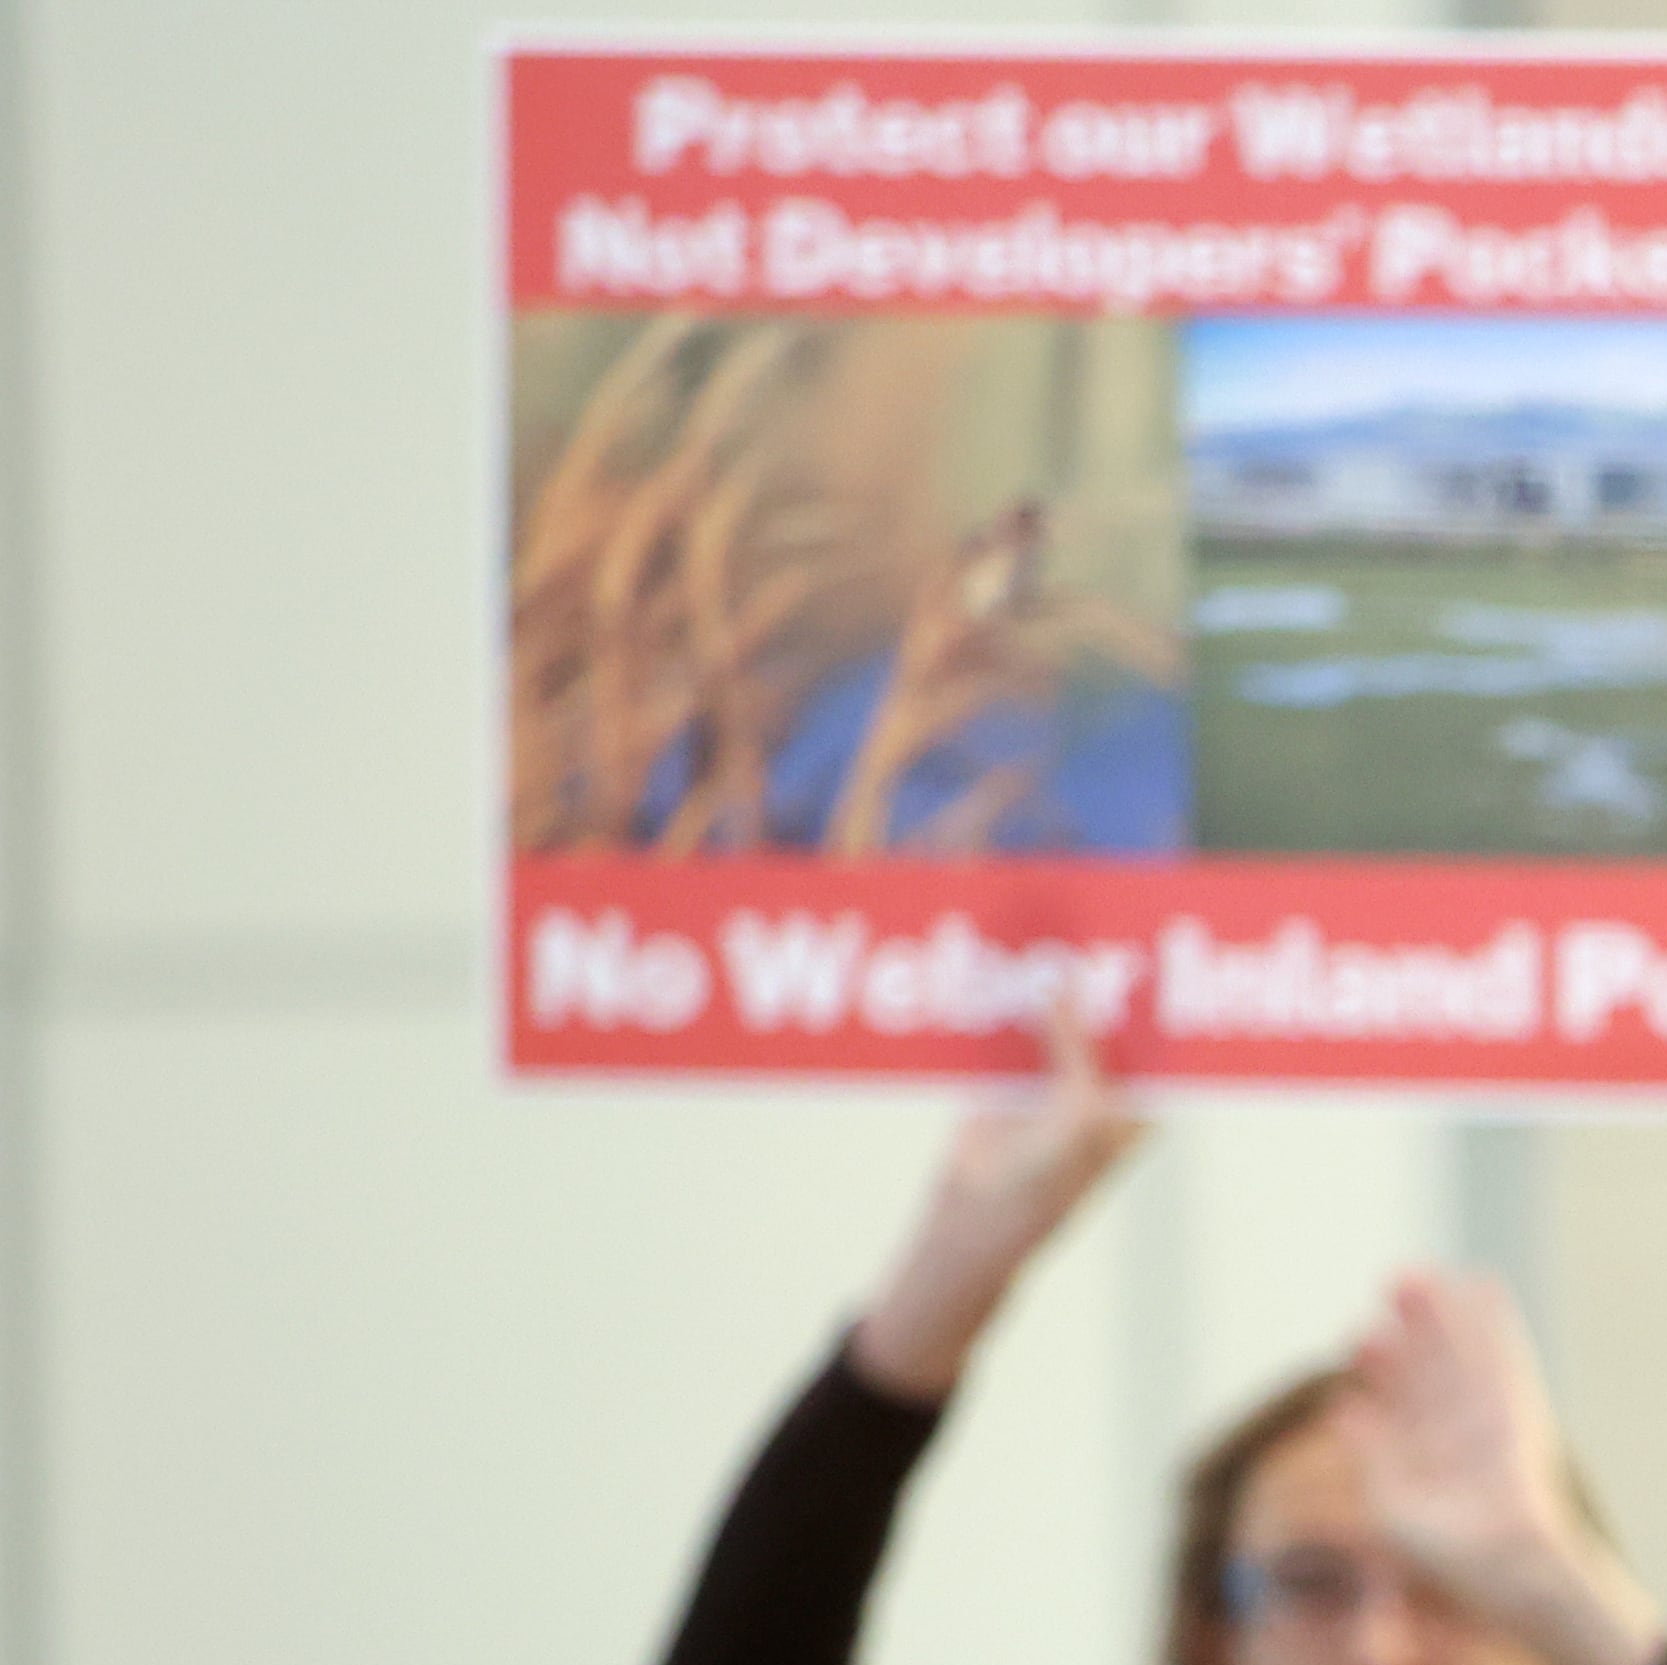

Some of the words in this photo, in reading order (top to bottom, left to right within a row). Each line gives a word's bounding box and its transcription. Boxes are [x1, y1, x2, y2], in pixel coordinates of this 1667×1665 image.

[630, 75, 1032, 182] Protect
[1042, 88, 1222, 180] our
[553, 198, 742, 298] Not
[530, 908, 710, 1036] No
[718, 908, 1148, 1038] Weber
[1155, 912, 1545, 1044] Inland
